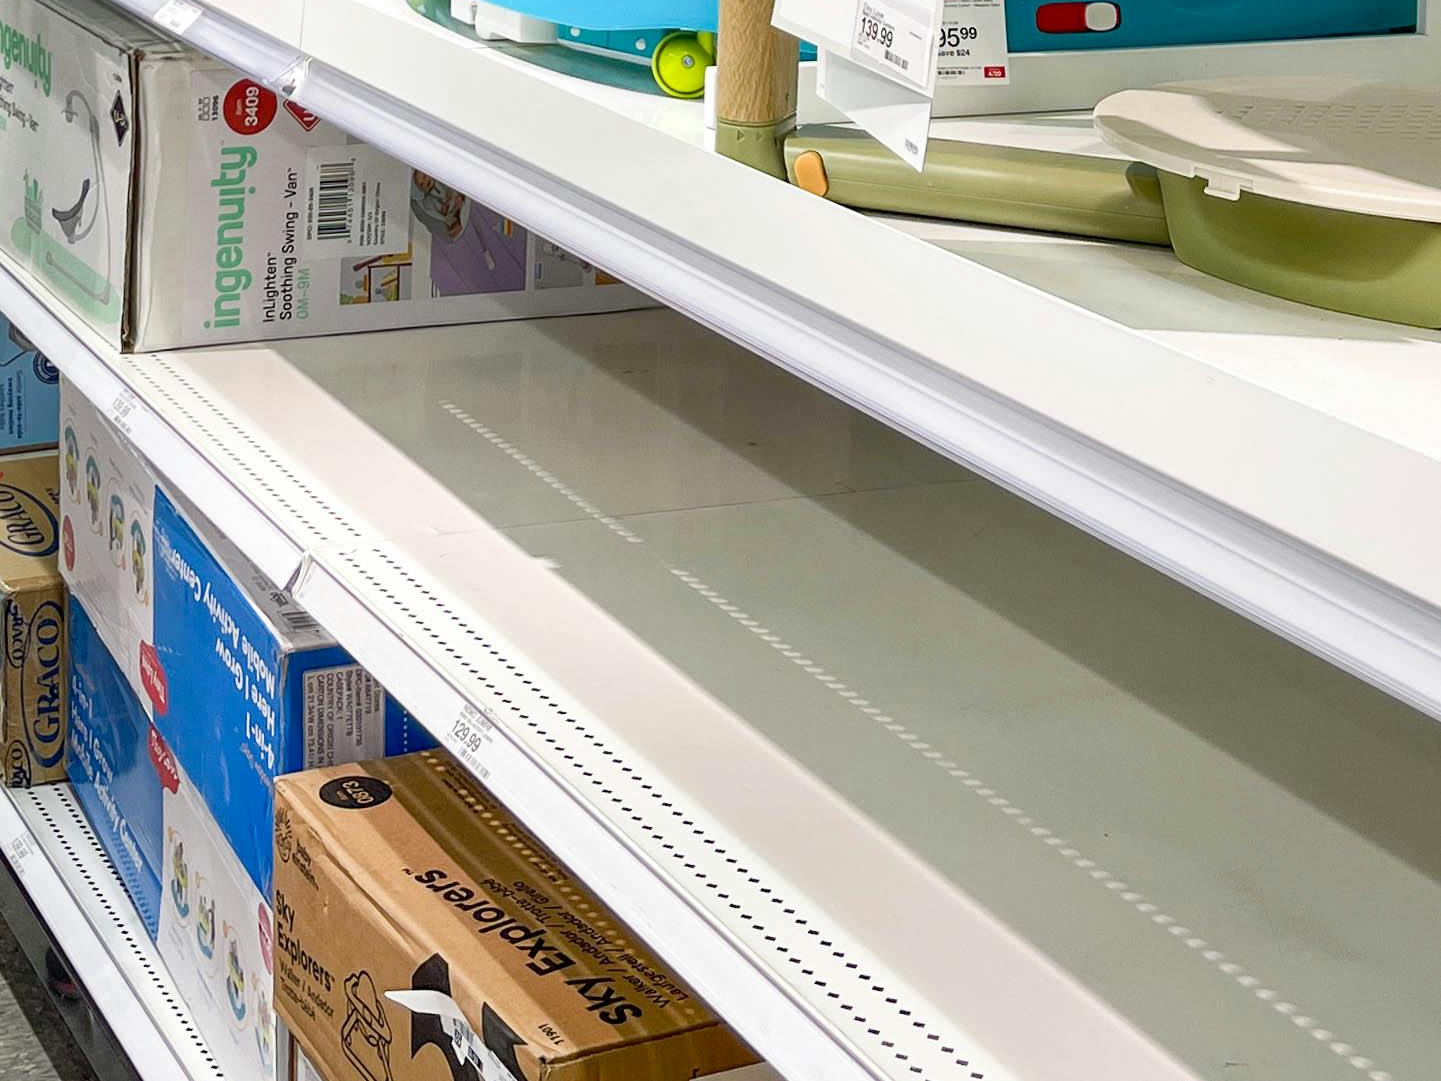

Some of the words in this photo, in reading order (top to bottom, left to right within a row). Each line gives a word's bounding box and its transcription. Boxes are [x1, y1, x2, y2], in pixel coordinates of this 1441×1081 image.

[861, 17, 894, 48] 139.99
[956, 49, 970, 57] $24
[244, 86, 260, 127] 3409
[284, 172, 298, 200] Van
[203, 144, 258, 329] ingenuity
[281, 210, 299, 254] Swing
[280, 256, 298, 321] Soothing
[33, 616, 61, 745] GRACO
[215, 638, 244, 691] Grow
[241, 636, 276, 699] Mobile
[250, 683, 276, 730] Here
[326, 673, 334, 710] COUNTRY
[451, 719, 482, 753] 129.99
[342, 780, 375, 804] 0873
[276, 889, 296, 933] Sky
[415, 868, 577, 977] Explorers
[559, 909, 615, 946] Andador
[277, 921, 332, 993] Explorers
[560, 929, 616, 966] Andador
[618, 953, 690, 1002] Laufgestell
[622, 974, 671, 1008] Walker
[564, 977, 643, 1025] Sky
[537, 1023, 566, 1046] 11901
